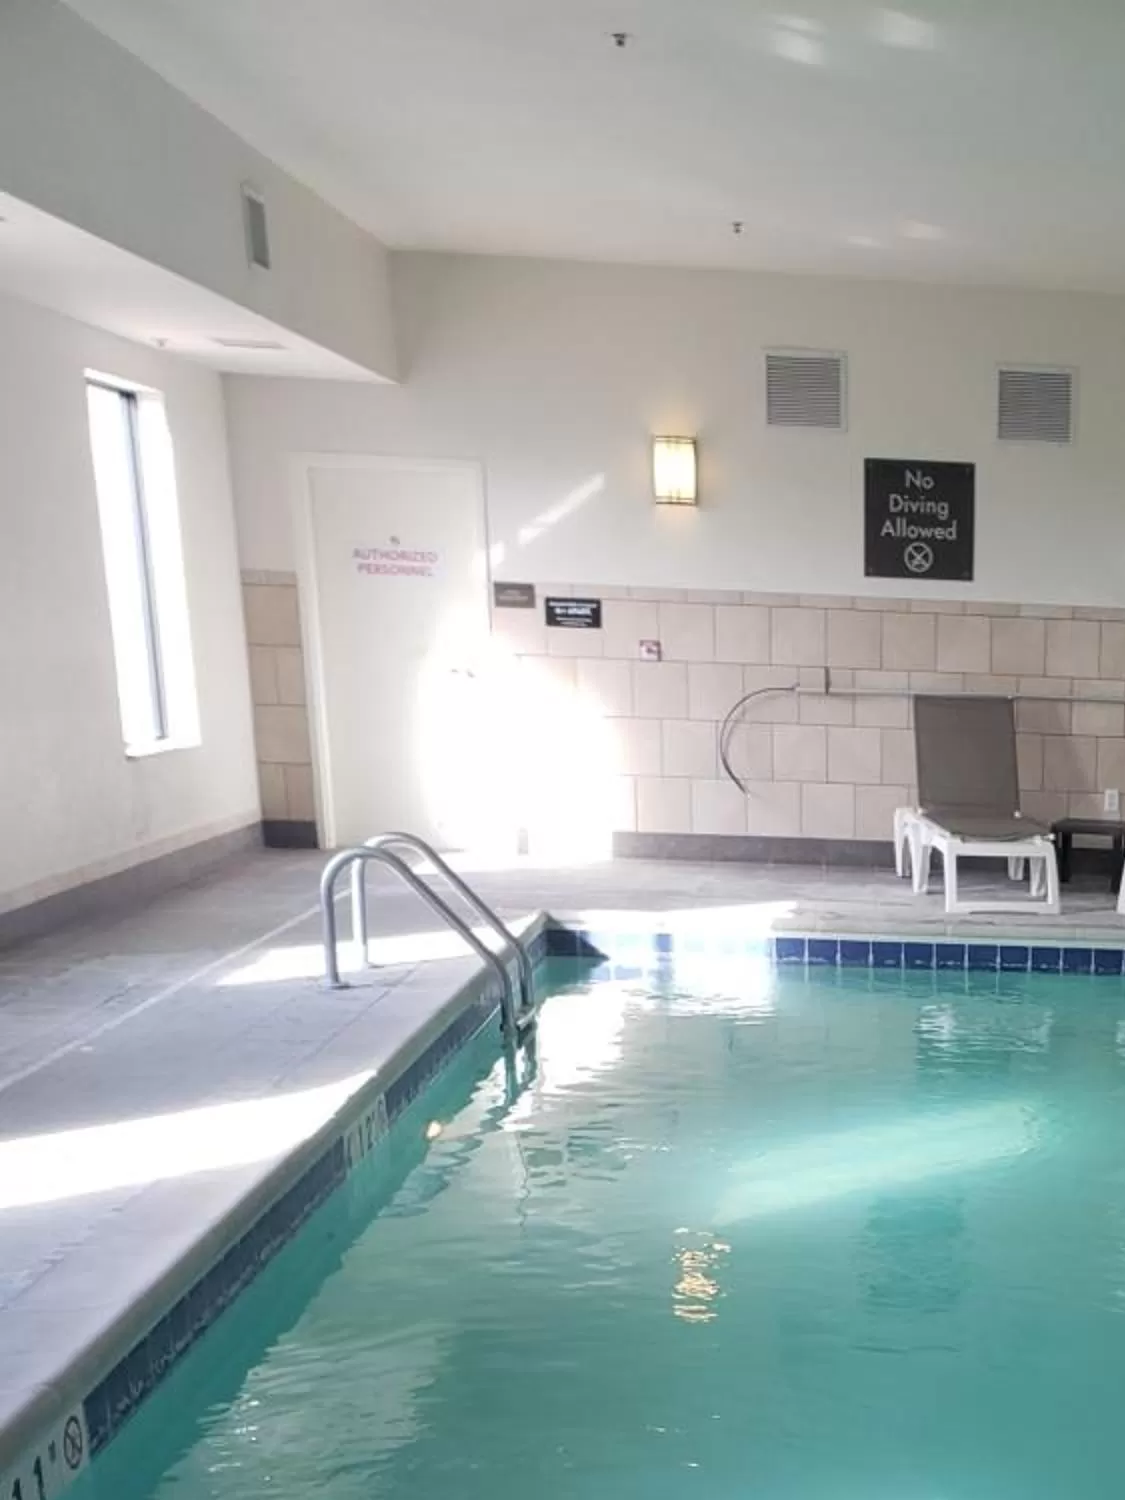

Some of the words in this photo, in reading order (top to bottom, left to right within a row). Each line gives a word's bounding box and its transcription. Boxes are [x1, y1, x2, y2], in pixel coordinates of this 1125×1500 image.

[904, 469, 935, 490] No
[888, 493, 950, 521] Diving
[880, 516, 958, 541] Allowed
[351, 547, 438, 564] AUTHORIZED
